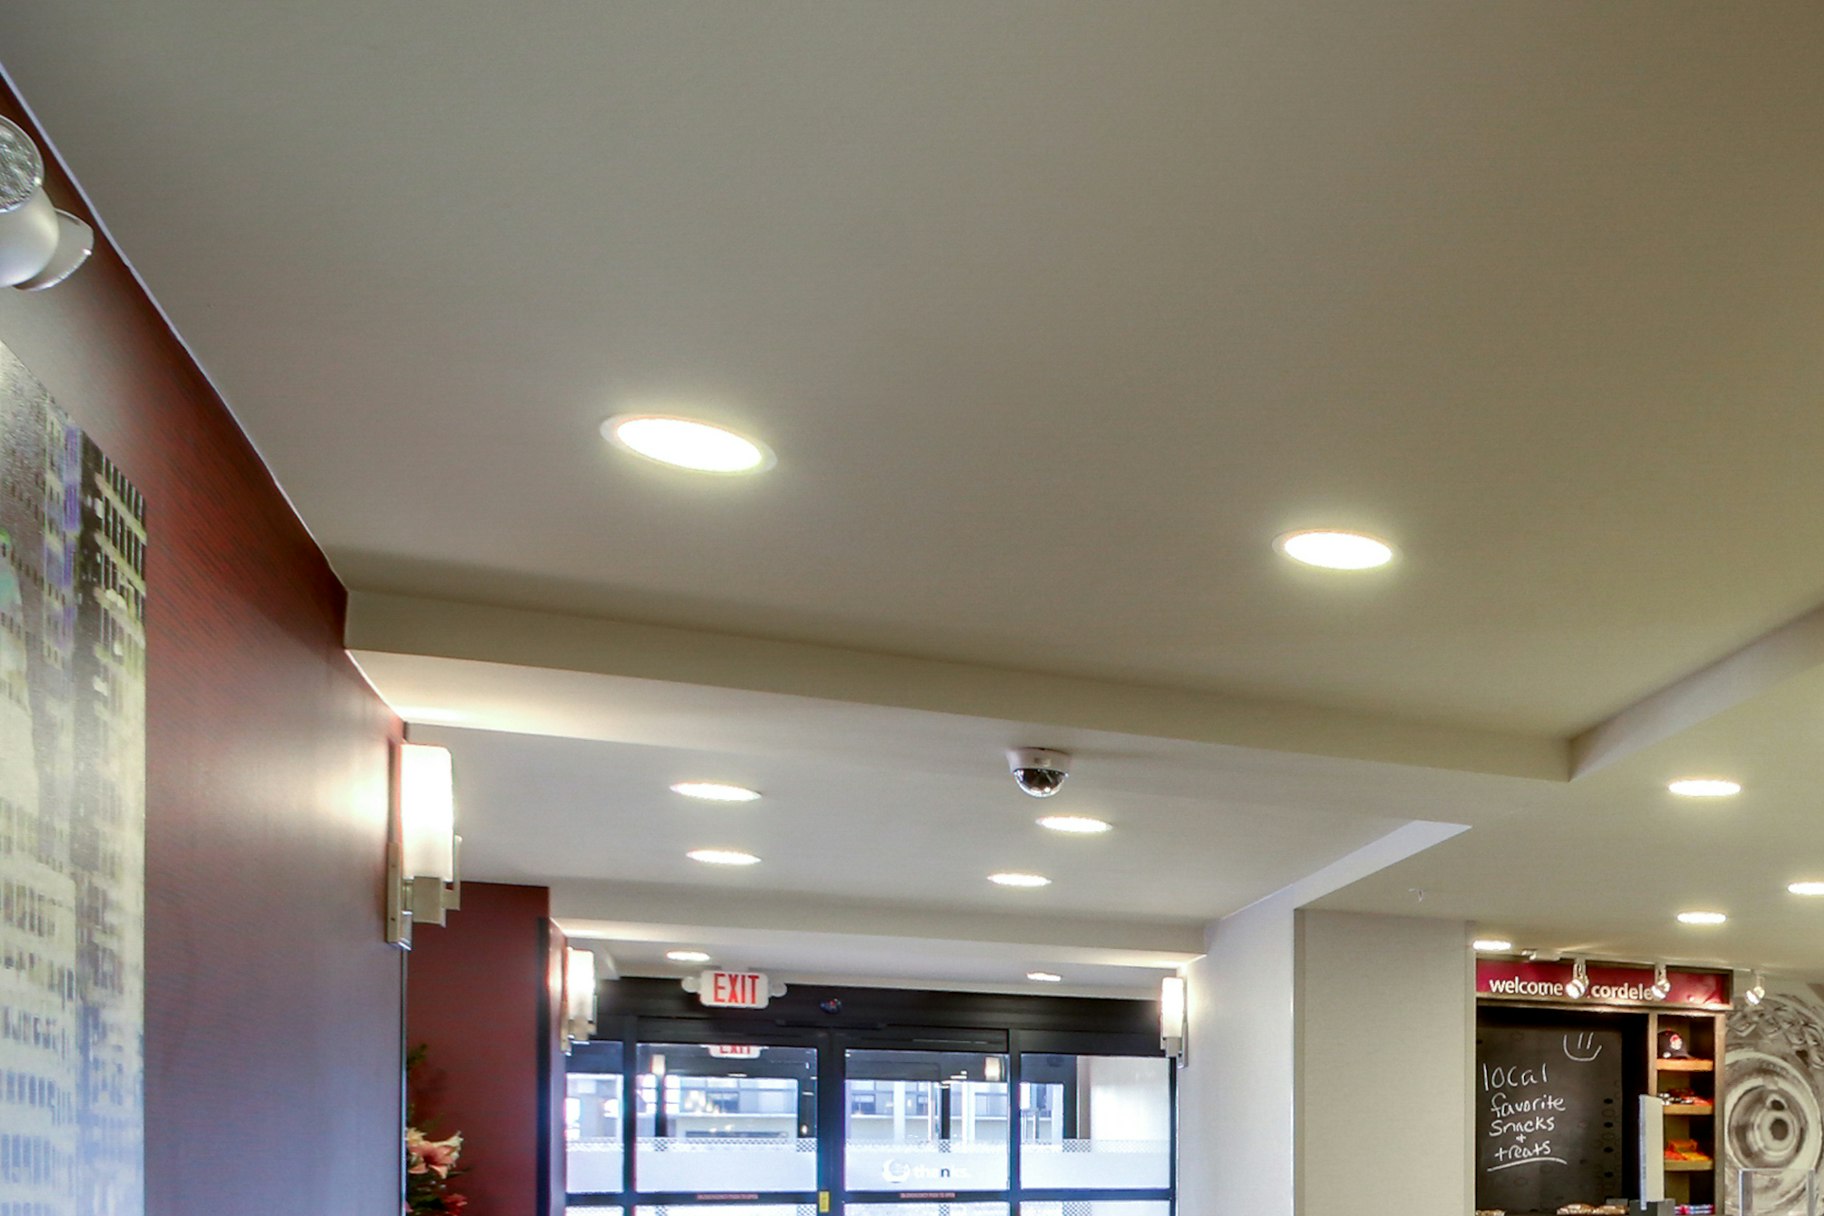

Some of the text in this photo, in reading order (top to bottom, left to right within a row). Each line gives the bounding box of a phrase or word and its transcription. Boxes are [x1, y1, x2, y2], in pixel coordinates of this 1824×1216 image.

[713, 973, 760, 1004] EXIT
[1489, 976, 1653, 1000] welcome cordele
[1483, 1063, 1548, 1091] local
[1490, 1092, 1566, 1118] favorite
[1494, 1140, 1551, 1161] treats
